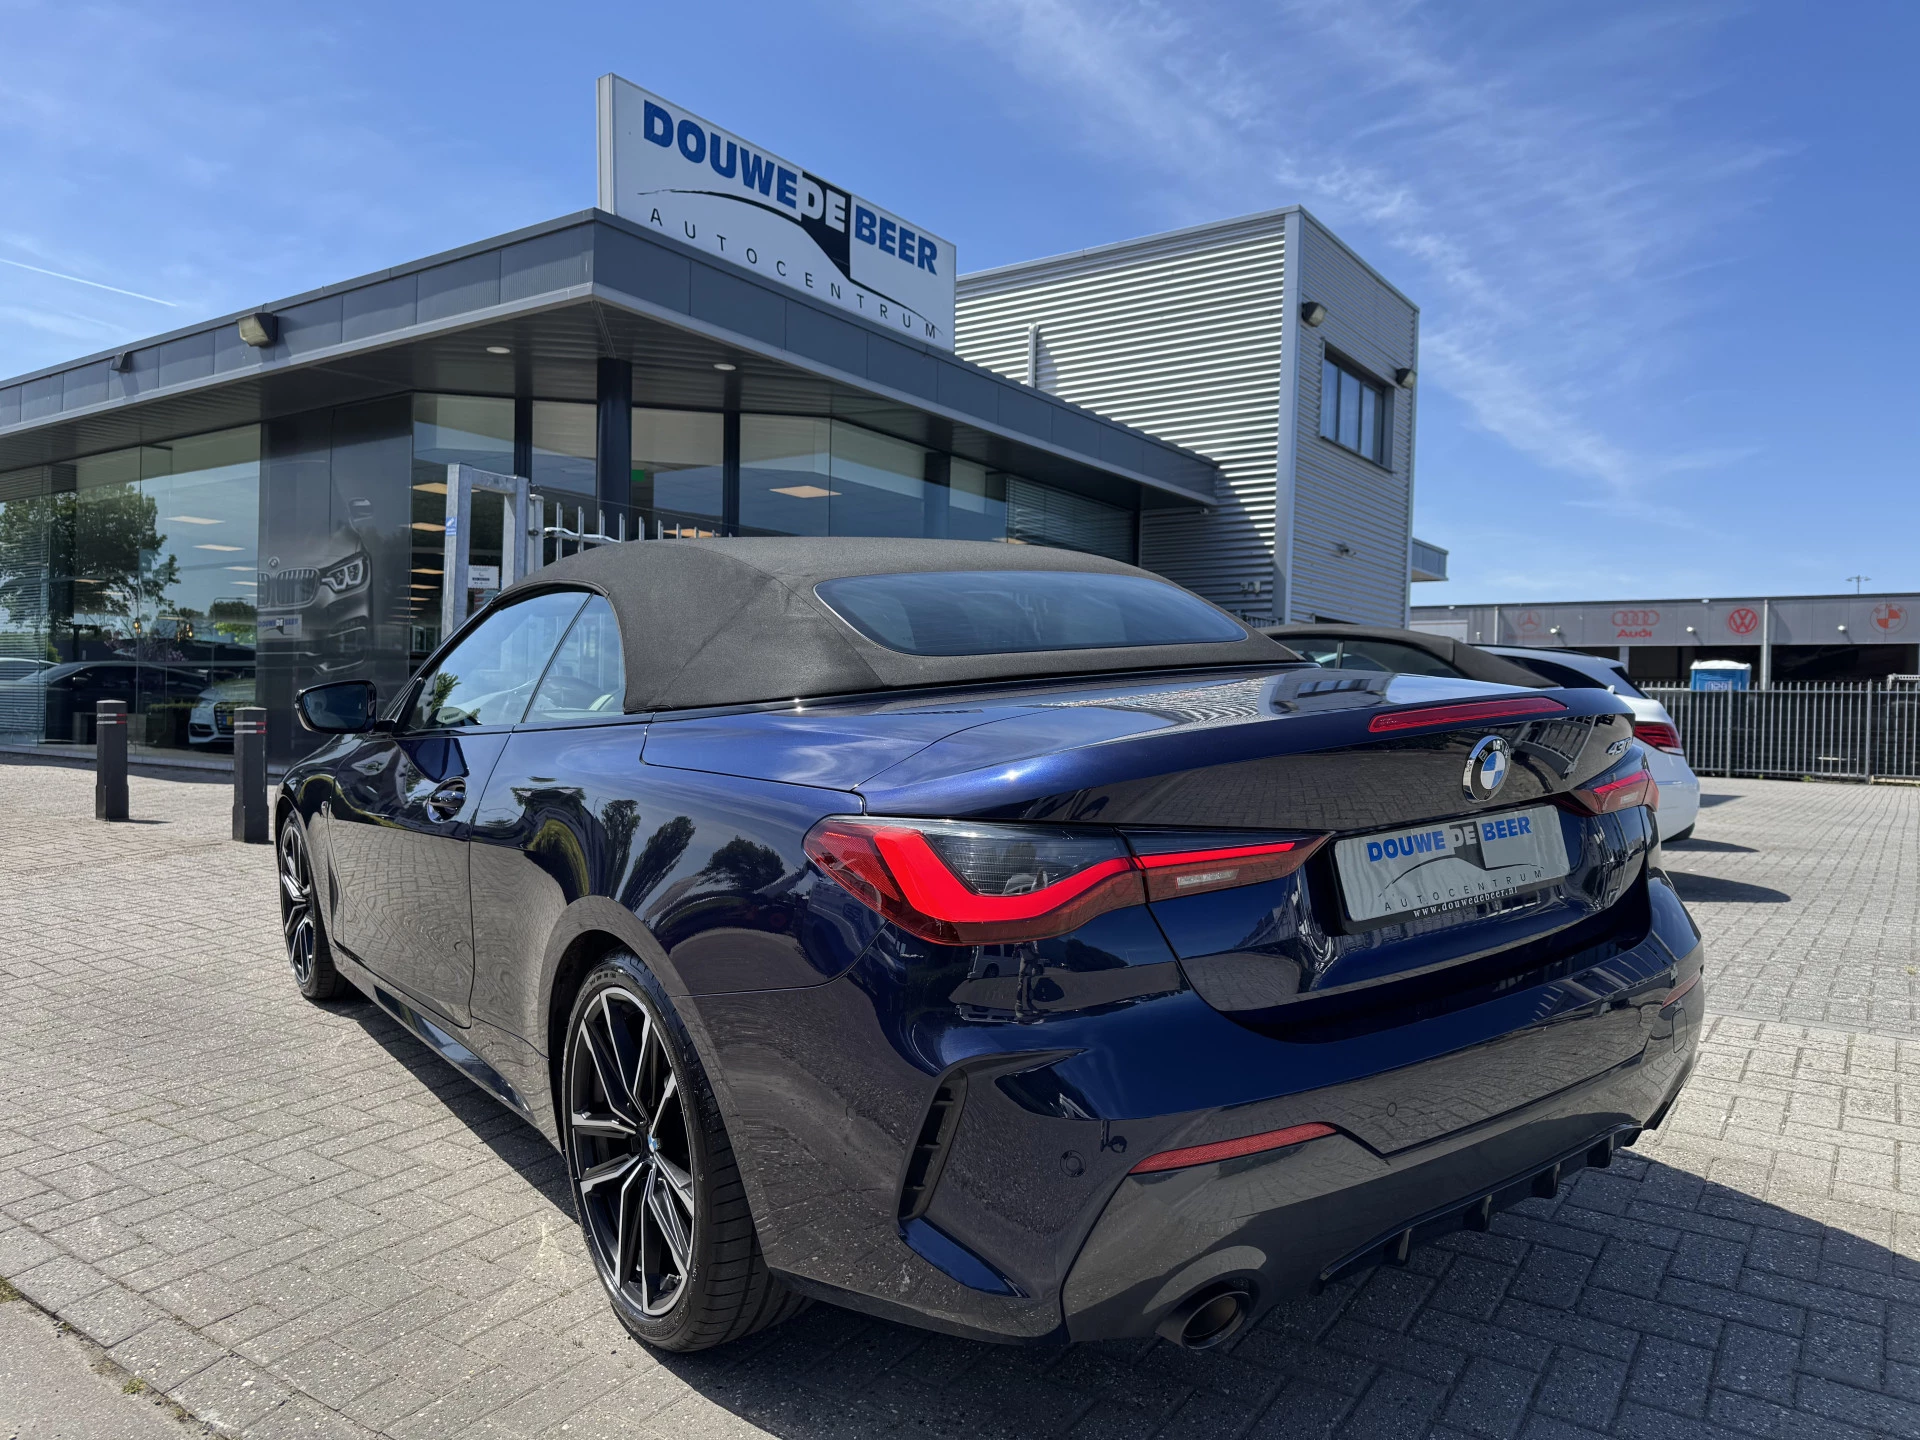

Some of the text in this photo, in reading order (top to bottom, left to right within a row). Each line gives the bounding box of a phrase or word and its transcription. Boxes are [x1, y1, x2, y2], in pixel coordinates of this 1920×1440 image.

[643, 99, 938, 276] DOUWE DE BEER
[650, 207, 936, 340] AUTOCENTRUM
[1616, 629, 1653, 638] Audi
[1478, 739, 1510, 762] BMW
[1366, 816, 1532, 862] DOUWE DE BEER
[1384, 870, 1542, 912] AUTOCENTRUM
[1412, 886, 1518, 918] www.douwedebeer.nl
